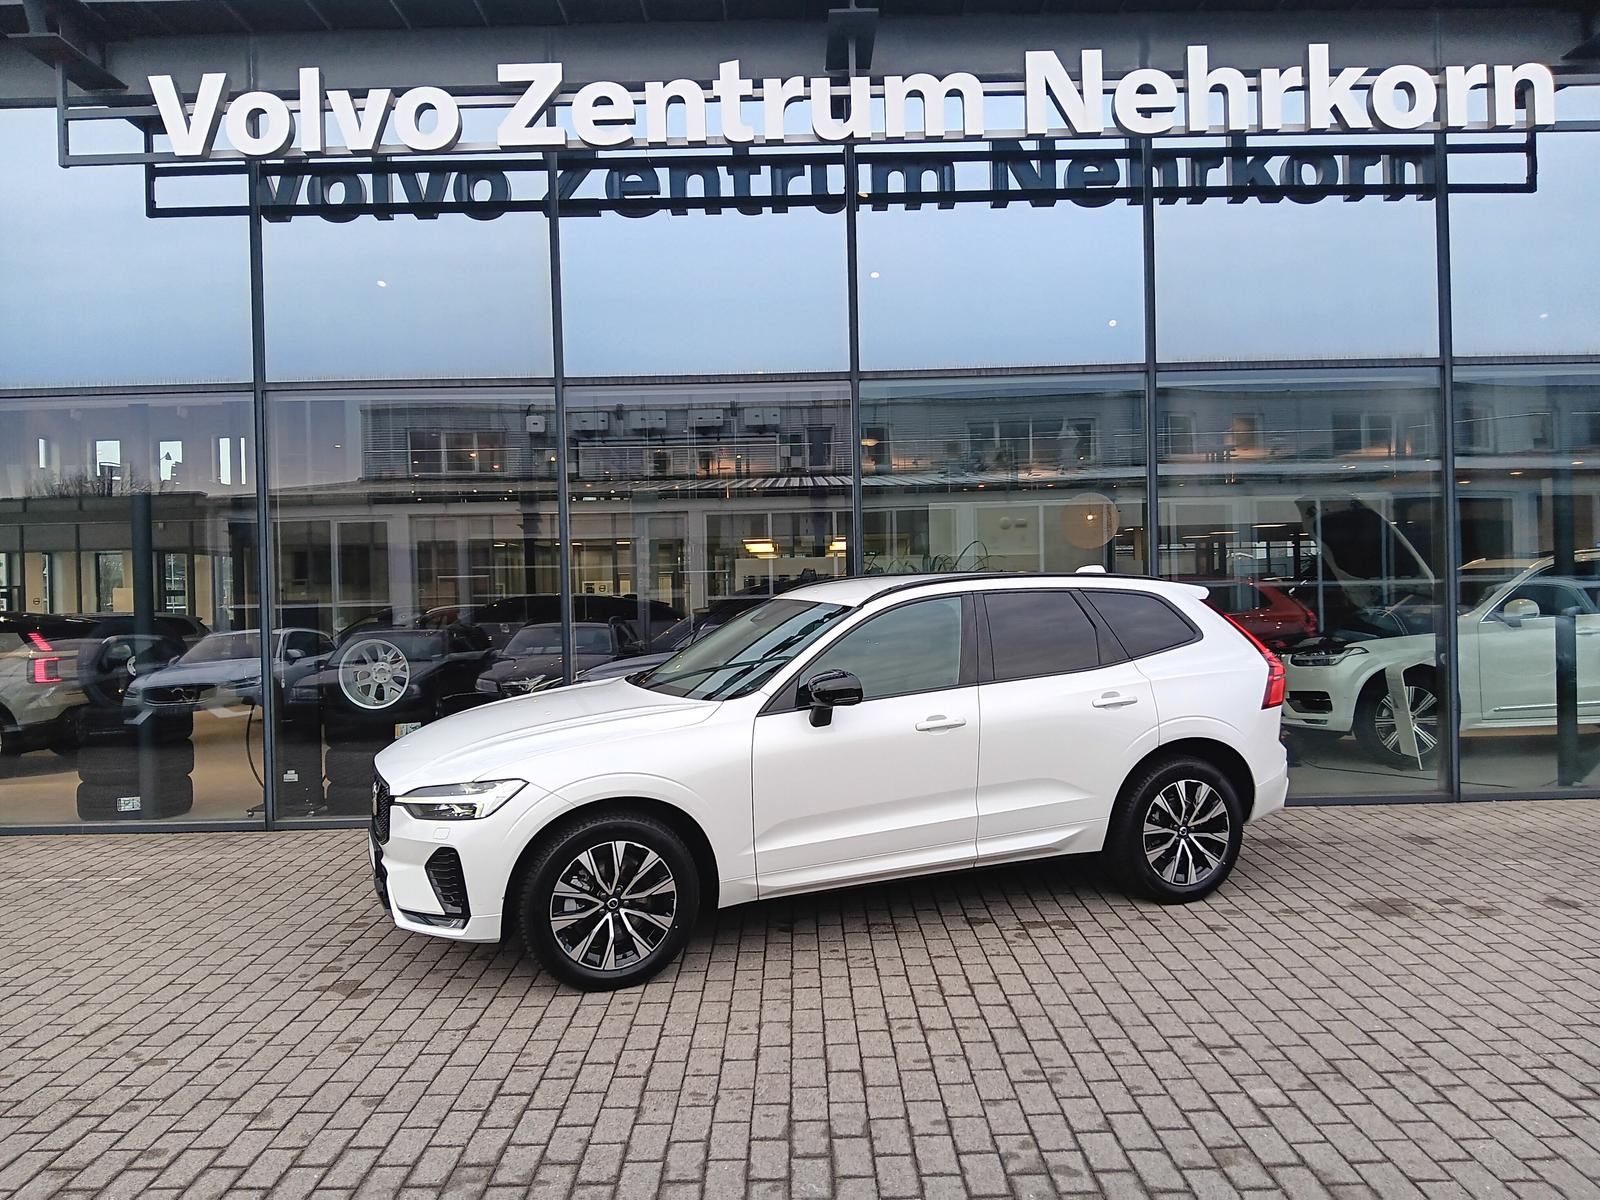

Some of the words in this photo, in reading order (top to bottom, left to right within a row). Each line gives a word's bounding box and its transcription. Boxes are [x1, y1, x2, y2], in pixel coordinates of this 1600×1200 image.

[148, 67, 461, 158] Volvo
[497, 60, 986, 149] Zentrum
[1024, 42, 1557, 136] Nehrkorn
